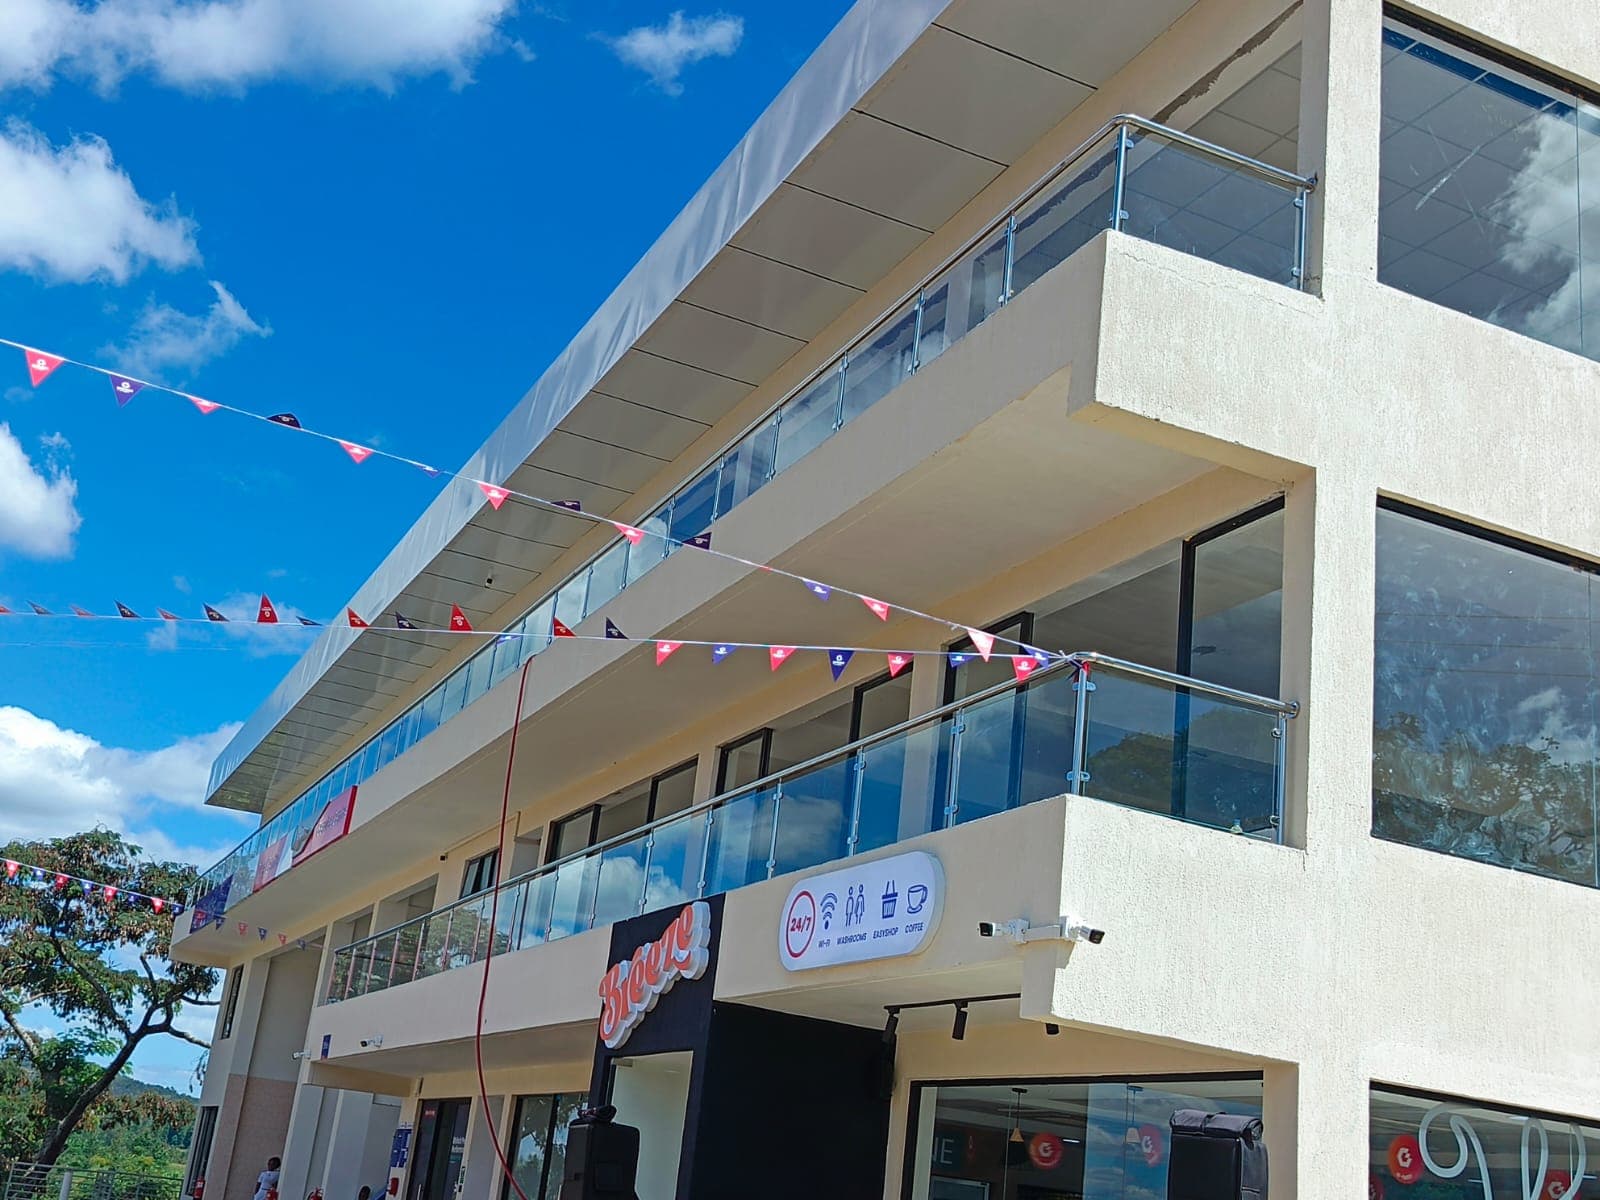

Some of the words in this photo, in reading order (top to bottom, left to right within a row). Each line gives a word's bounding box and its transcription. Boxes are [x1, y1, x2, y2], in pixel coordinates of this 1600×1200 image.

[790, 915, 811, 932] 24/7
[837, 932, 866, 945] WASHROOMS
[873, 927, 899, 939] EASYSHOP
[905, 922, 924, 934] COFFEE
[598, 905, 695, 1040] Breeze
